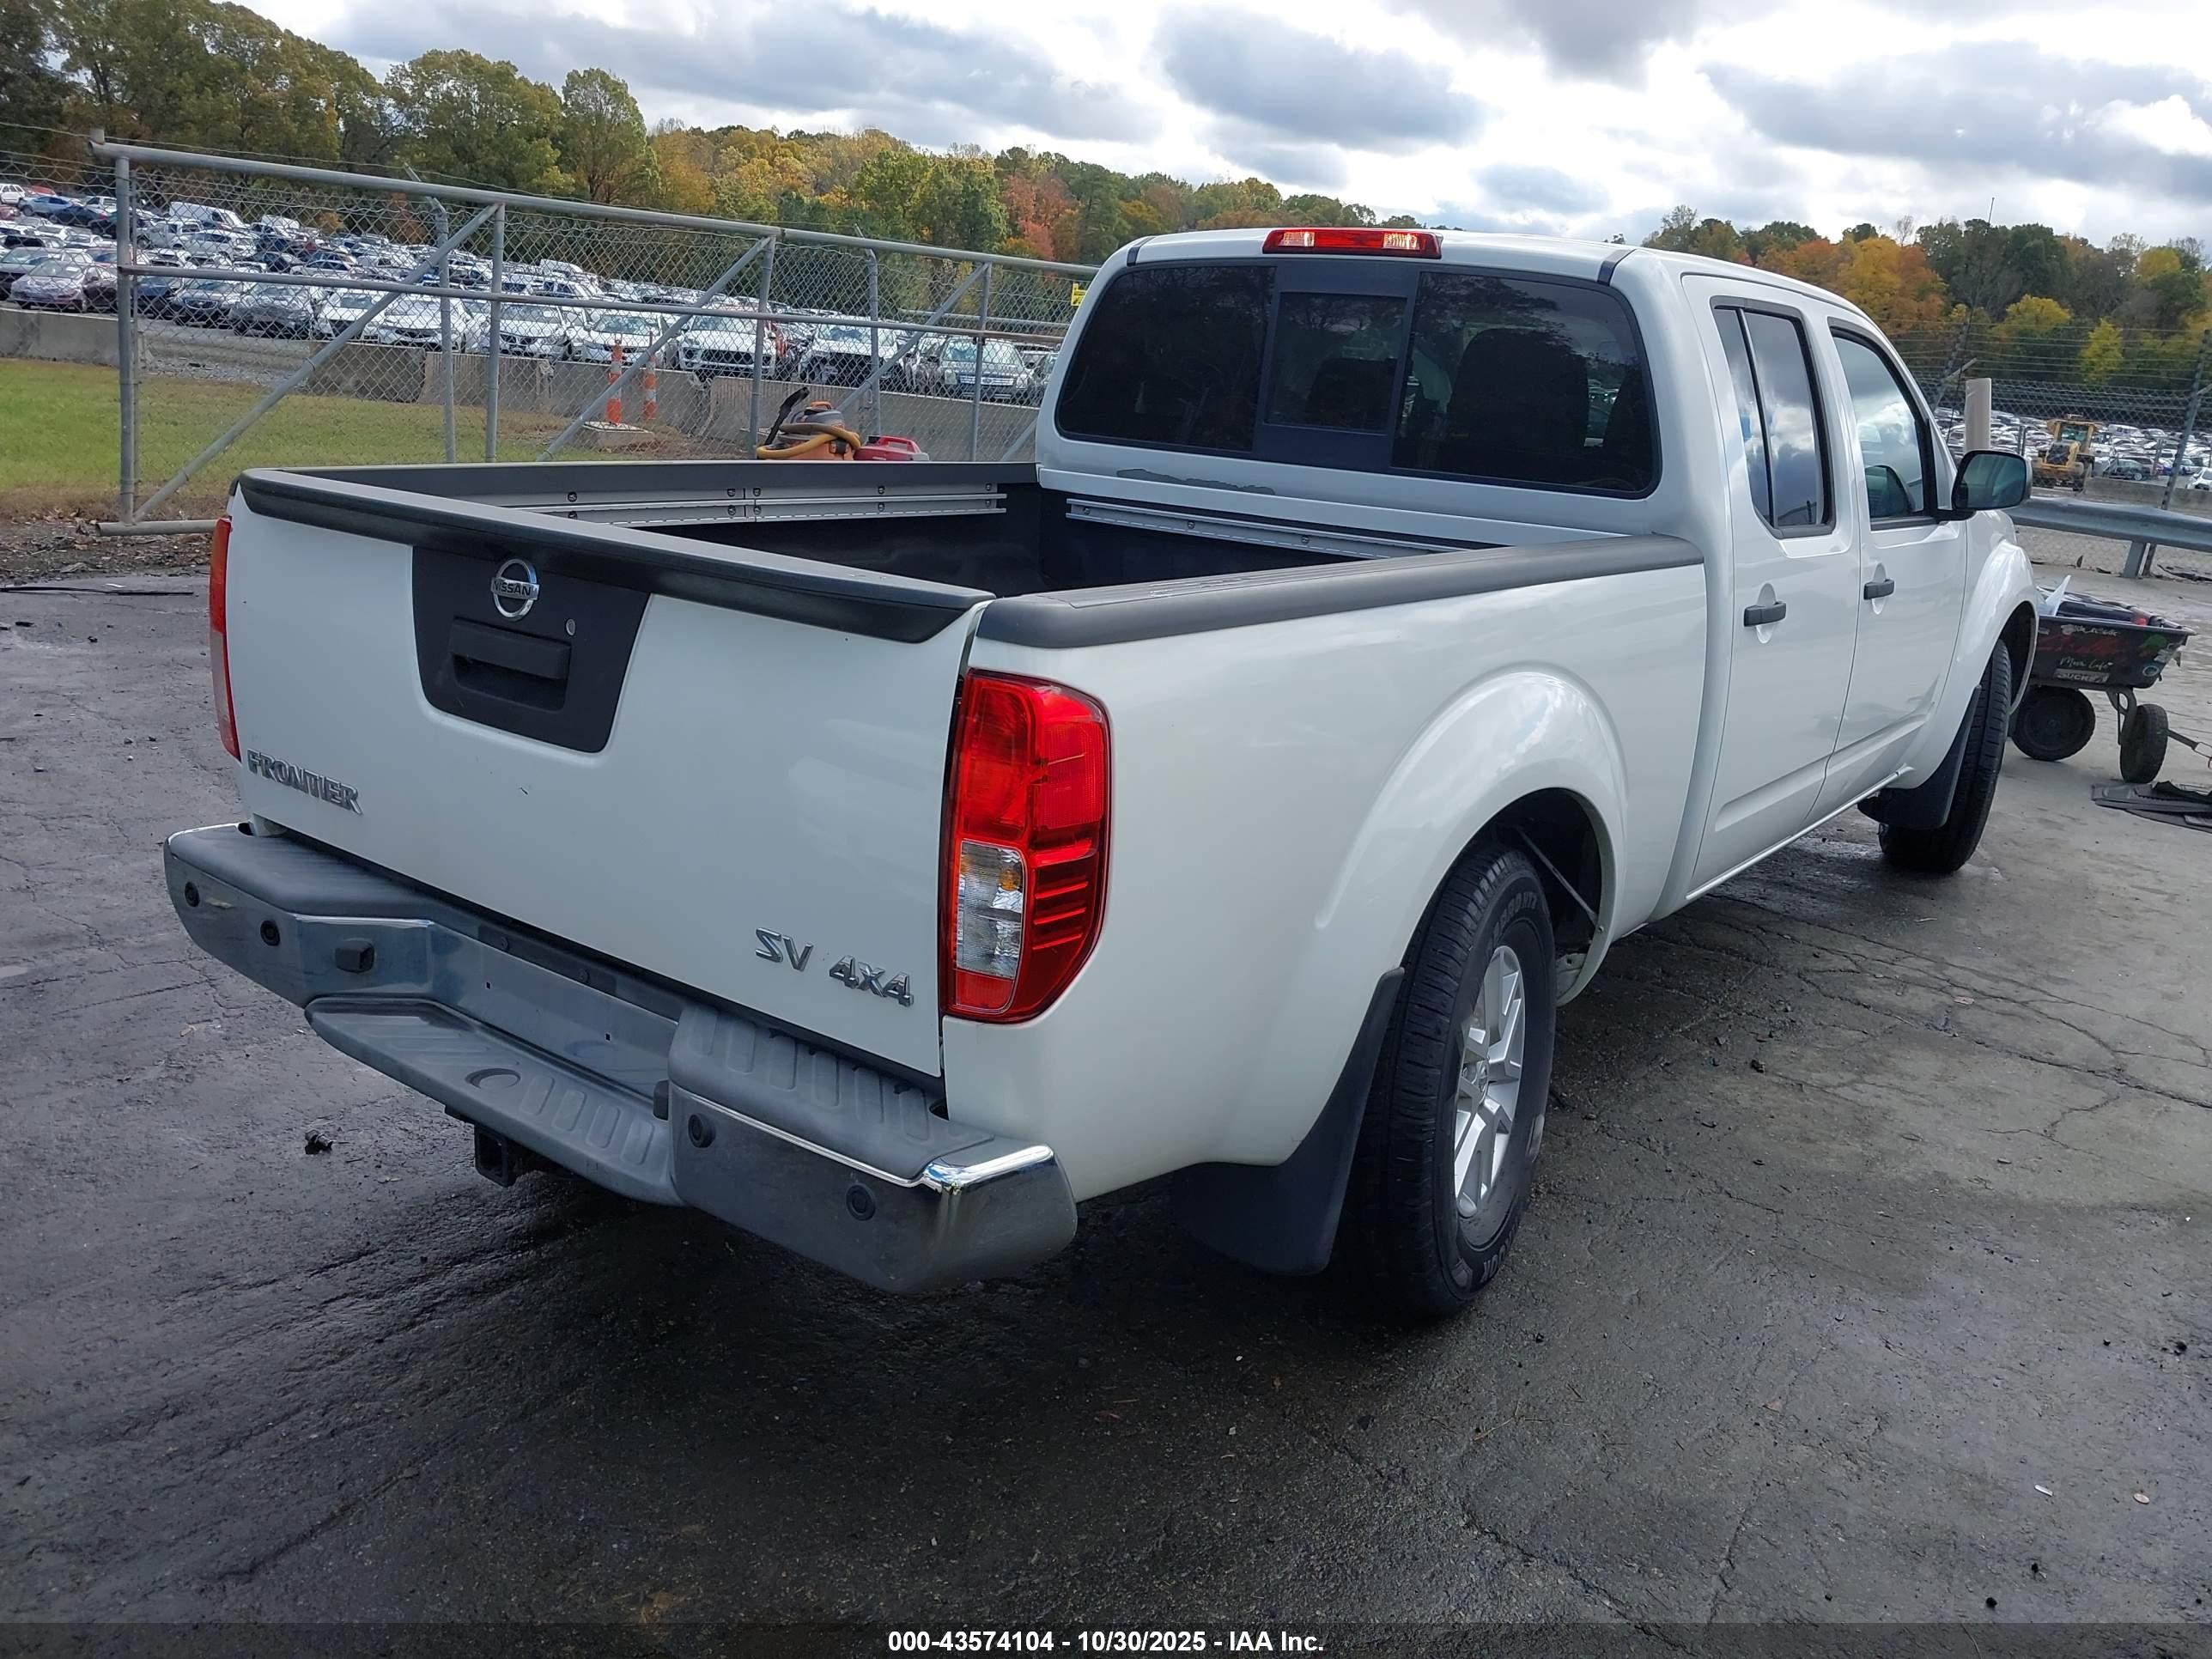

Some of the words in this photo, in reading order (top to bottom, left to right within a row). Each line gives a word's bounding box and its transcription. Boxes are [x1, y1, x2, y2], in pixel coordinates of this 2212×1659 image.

[493, 580, 532, 596] NISSAN
[247, 748, 363, 816] FRONTIER
[755, 927, 814, 972] SV
